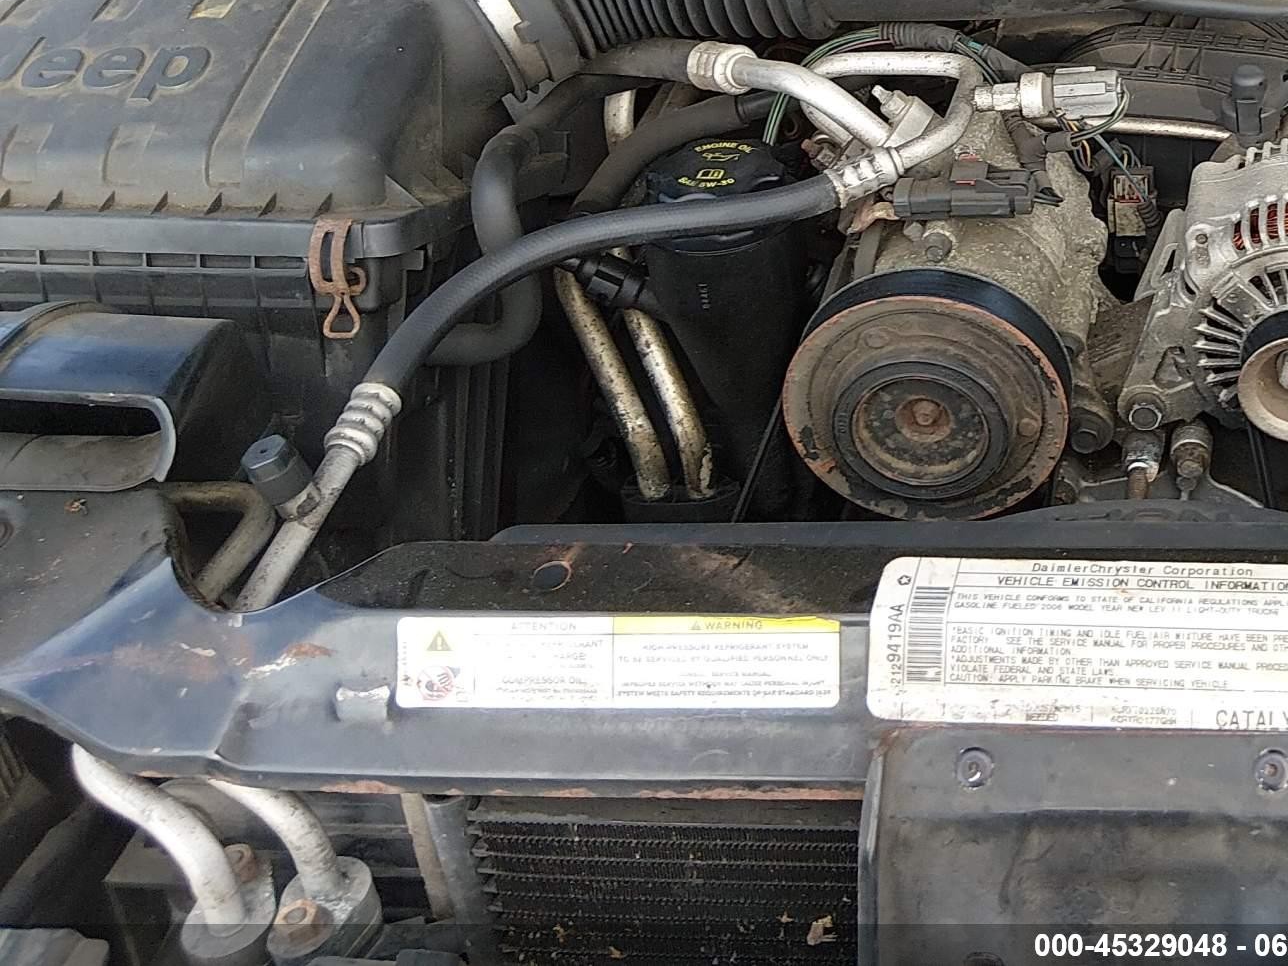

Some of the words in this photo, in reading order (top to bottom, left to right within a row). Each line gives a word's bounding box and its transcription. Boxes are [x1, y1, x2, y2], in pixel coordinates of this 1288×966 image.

[694, 142, 738, 152] ENGINE
[737, 144, 753, 154] OIL
[1032, 562, 1154, 575] DaimlerChrysler
[1163, 565, 1253, 577] Corporation
[998, 576, 1054, 586] VEHICLE
[1063, 578, 1129, 588] EMISSION
[1137, 578, 1195, 590] CONTROL
[984, 593, 1021, 601] VEHICLE
[1026, 594, 1069, 602] CONFORMS
[1123, 595, 1135, 603] OF
[1140, 596, 1193, 605] CALIFORNIA
[1199, 597, 1258, 606] REGULATIONS
[954, 601, 997, 609] GASOLINE
[1002, 602, 1035, 610] FUELED
[1068, 603, 1093, 611] MODEL
[1101, 603, 1122, 611] YEAR
[511, 622, 577, 631] ATTENTION
[705, 620, 763, 631] WARNING
[991, 628, 1033, 636] IGNITION
[1039, 629, 1071, 637] TIMING
[1077, 629, 1093, 637] AND
[1100, 630, 1120, 638] IDLE
[1219, 634, 1240, 642] HAVE
[1246, 634, 1268, 642] BEEN
[951, 645, 1004, 654] ADDITIONAL
[1007, 637, 1022, 645] SEE
[1028, 637, 1044, 645] THE
[1050, 638, 1088, 646] SERVICE
[1093, 639, 1125, 647] MANUAL
[1131, 640, 1148, 648] FOR
[1153, 641, 1185, 649] PROPER
[1191, 642, 1246, 651] PROCEDURES
[1251, 643, 1268, 651] AND
[1021, 656, 1044, 664] MADE
[1049, 657, 1059, 665] BY
[1066, 658, 1093, 666] OTHER
[1100, 658, 1120, 666] THAN
[1126, 659, 1168, 668] APPROVED
[1175, 661, 1212, 669] SERVICE
[1218, 662, 1250, 670] MANUAL
[951, 664, 988, 673] VIOLATE
[994, 665, 1031, 674] FEDERAL
[1038, 666, 1054, 674] AND
[1059, 667, 1086, 675] STATE
[502, 676, 565, 685] COMPRESSOR
[999, 674, 1026, 682] APPLY
[1032, 675, 1070, 683] PARKING
[1076, 675, 1101, 684] BRAKE
[1109, 676, 1130, 684] WHEN
[1136, 677, 1184, 687] SERVICING
